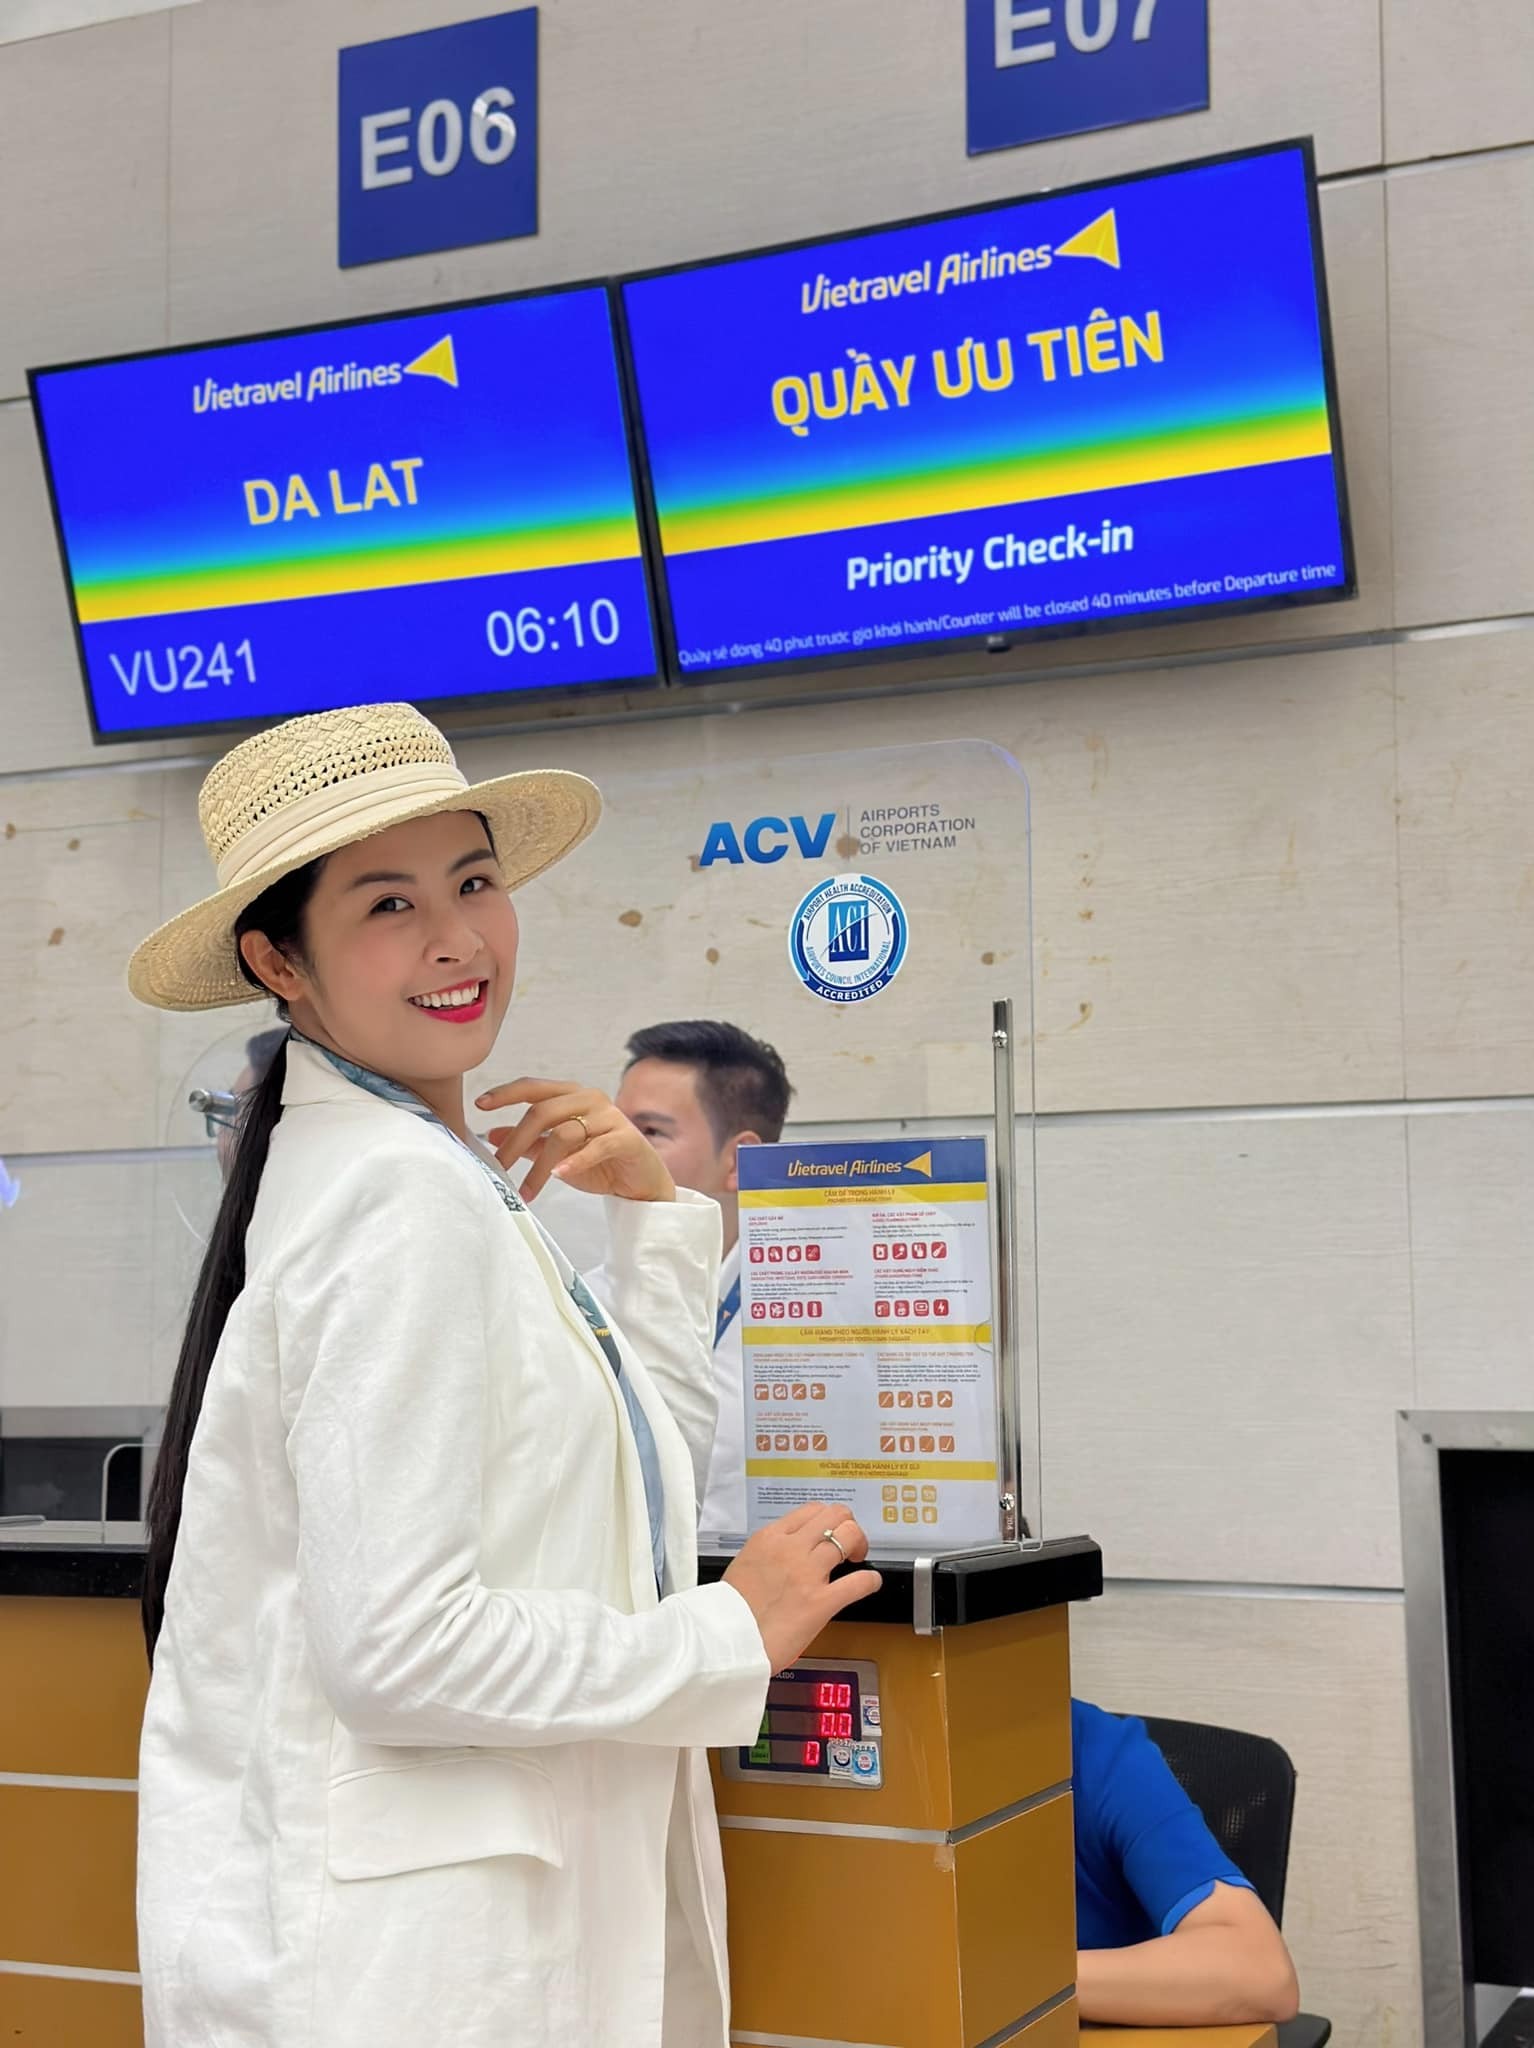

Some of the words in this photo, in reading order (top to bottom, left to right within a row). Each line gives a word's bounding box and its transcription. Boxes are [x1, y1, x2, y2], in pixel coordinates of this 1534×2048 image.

[361, 86, 517, 190] E06
[801, 260, 931, 314] Vietravel
[936, 244, 1053, 295] Airlines
[193, 371, 302, 414] Vietravel
[307, 362, 402, 402] Airlines
[771, 348, 916, 437] QUẦY
[932, 337, 1014, 399] ƯU
[1026, 307, 1164, 383] TIÊN
[244, 474, 320, 526] DA
[329, 457, 423, 514] LAT
[847, 545, 974, 591] Priority
[984, 519, 1134, 570] Check-in
[764, 637, 783, 652] 40
[997, 606, 1022, 622] will
[1024, 603, 1042, 619] be
[1044, 596, 1089, 616] closed
[1091, 592, 1111, 608] 40
[1113, 585, 1172, 607] minutes
[1174, 579, 1221, 598] before
[1224, 568, 1298, 593] Departure
[1301, 563, 1336, 581] time
[109, 639, 257, 696] VU241
[486, 598, 620, 657] 06:10
[860, 804, 940, 822] AIRPORTS
[860, 817, 976, 839] CORPORATION
[699, 813, 836, 867] ACV
[860, 841, 880, 855] OF
[887, 835, 956, 852] VIETNAM
[803, 894, 826, 921] AIRPORT
[824, 883, 849, 899] HEALTH
[850, 883, 892, 915] ACCREDITATION
[831, 905, 867, 953] ACI
[806, 946, 827, 976] AIRPORTS
[825, 970, 853, 984] COUNCIL
[854, 940, 891, 984] INTERNATIONAL
[816, 980, 883, 1000] ACCREDITED
[787, 1159, 848, 1177] Vietravel
[849, 1159, 902, 1178] Airlines
[820, 1683, 851, 1708] 0.0
[820, 1712, 852, 1737] 0.0
